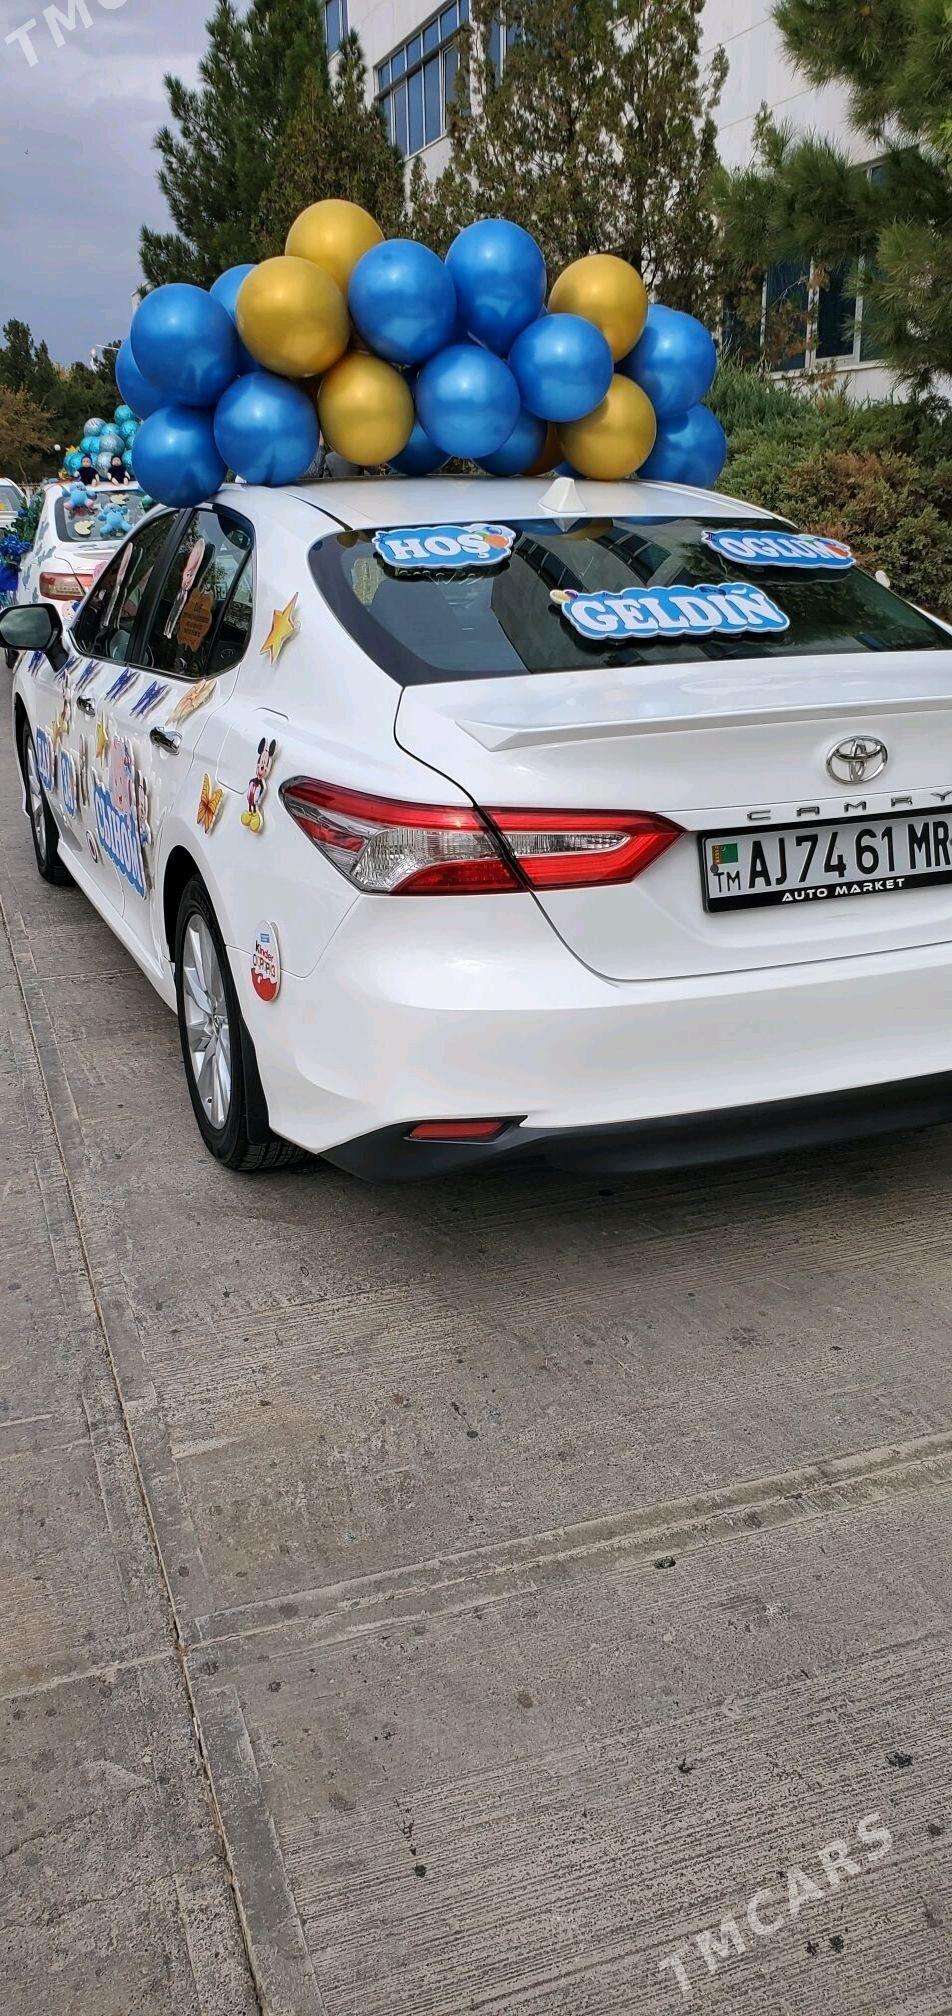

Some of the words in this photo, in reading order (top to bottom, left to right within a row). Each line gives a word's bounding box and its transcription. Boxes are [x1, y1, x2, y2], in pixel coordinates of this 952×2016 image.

[384, 533, 491, 560] HOŞ
[747, 790, 952, 821] CAMRY
[713, 869, 741, 893] TM
[782, 886, 828, 902] AUTO
[834, 877, 906, 895] MARKET
